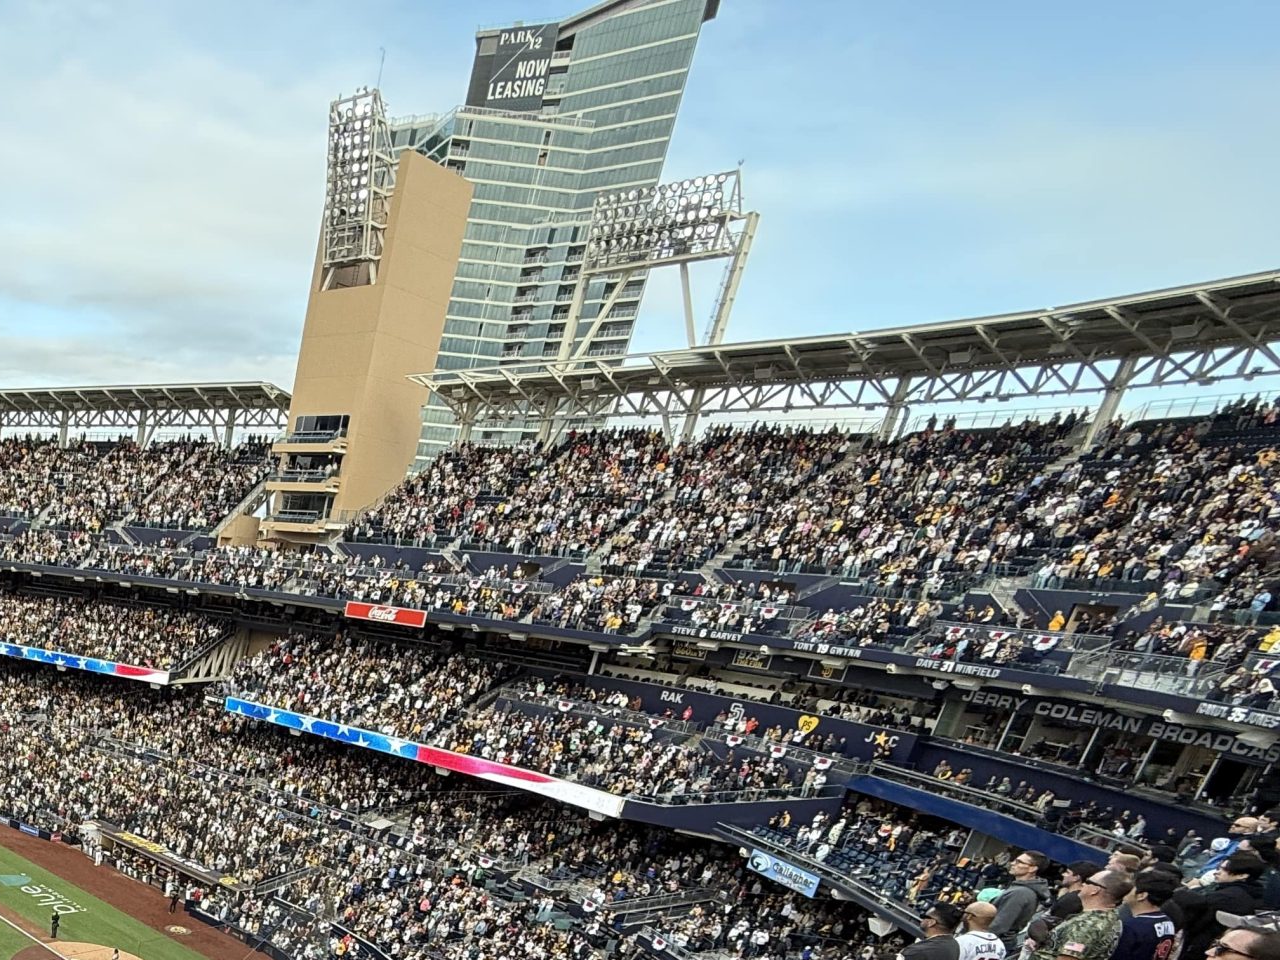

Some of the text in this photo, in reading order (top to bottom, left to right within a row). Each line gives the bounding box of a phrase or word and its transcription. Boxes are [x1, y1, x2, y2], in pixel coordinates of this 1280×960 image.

[500, 29, 535, 45] PARK
[516, 58, 550, 79] NOW
[487, 78, 545, 100] LEASING
[671, 627, 743, 641] STEVE 6 GARVEY
[793, 642, 862, 658] TONY 19 GWYNN
[916, 659, 1001, 677] DAVE 31 WINFIELD
[660, 690, 684, 704] RAK
[962, 691, 1028, 710] JERRY
[1035, 702, 1143, 733] COLEMAN
[773, 862, 815, 890] Gallagher
